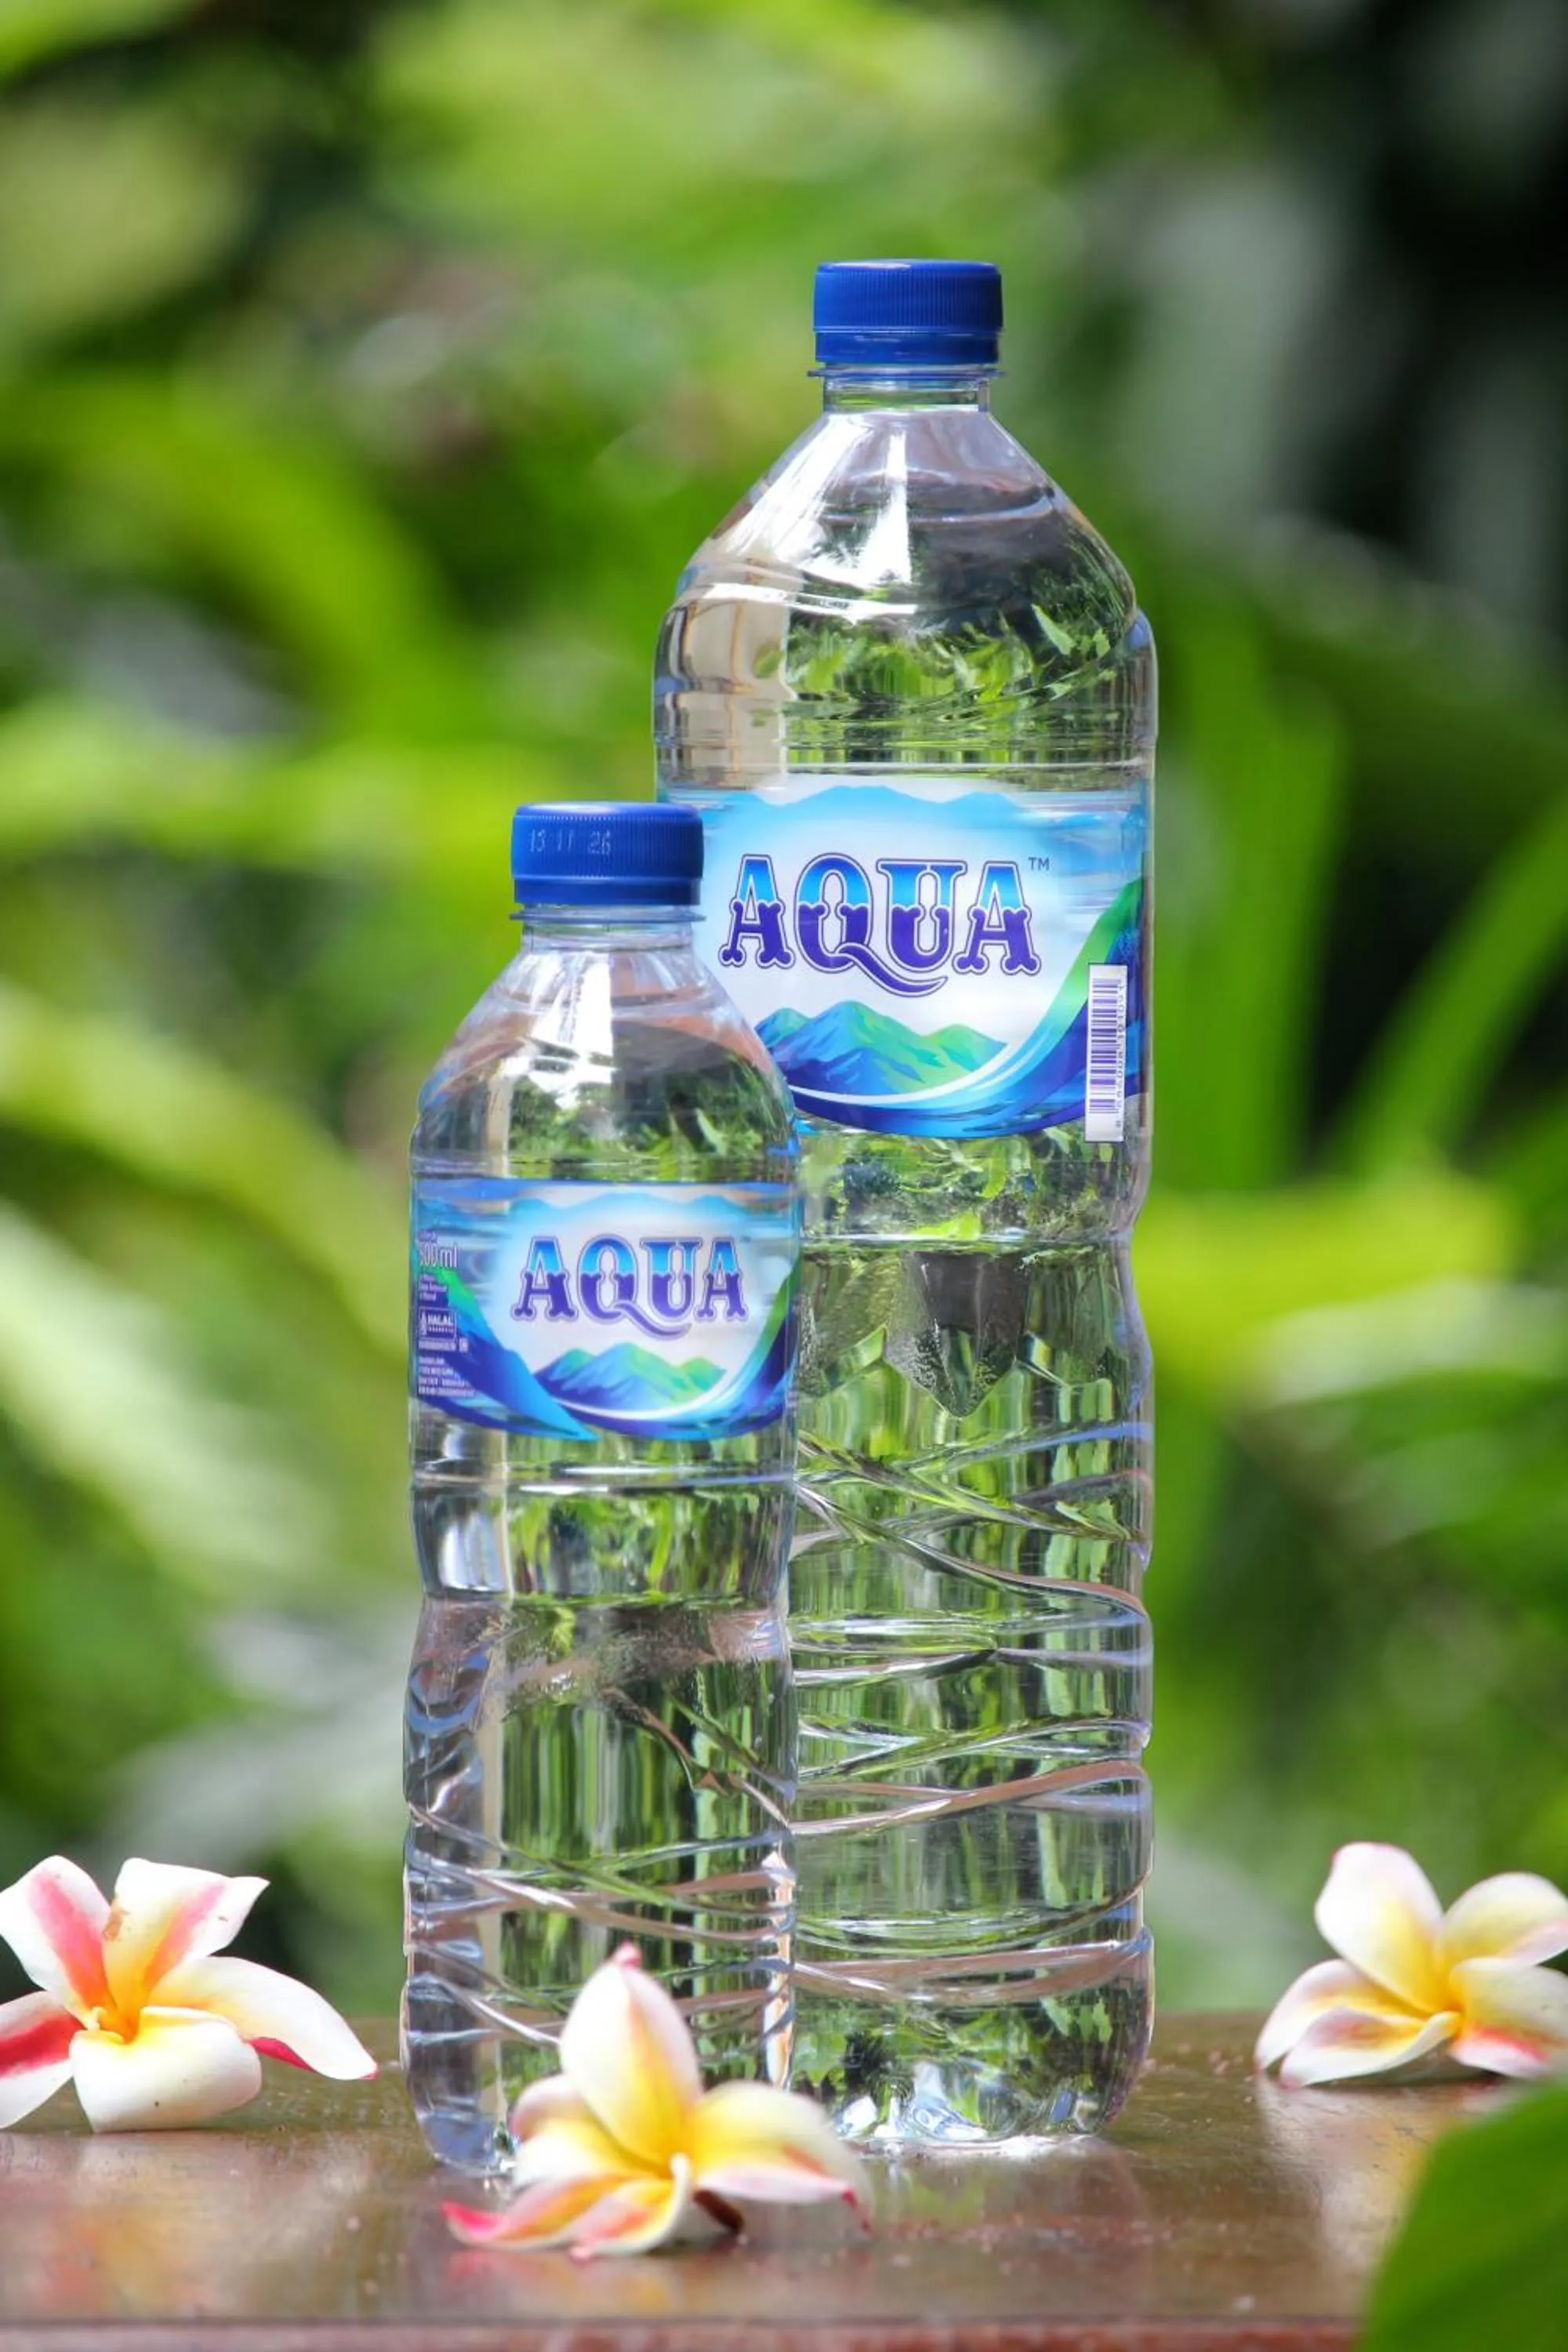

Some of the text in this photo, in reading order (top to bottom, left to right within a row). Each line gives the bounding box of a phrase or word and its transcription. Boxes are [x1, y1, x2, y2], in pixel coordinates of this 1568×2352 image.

[718, 852, 1050, 997] AQUA TM
[510, 1233, 750, 1341] AQUA
